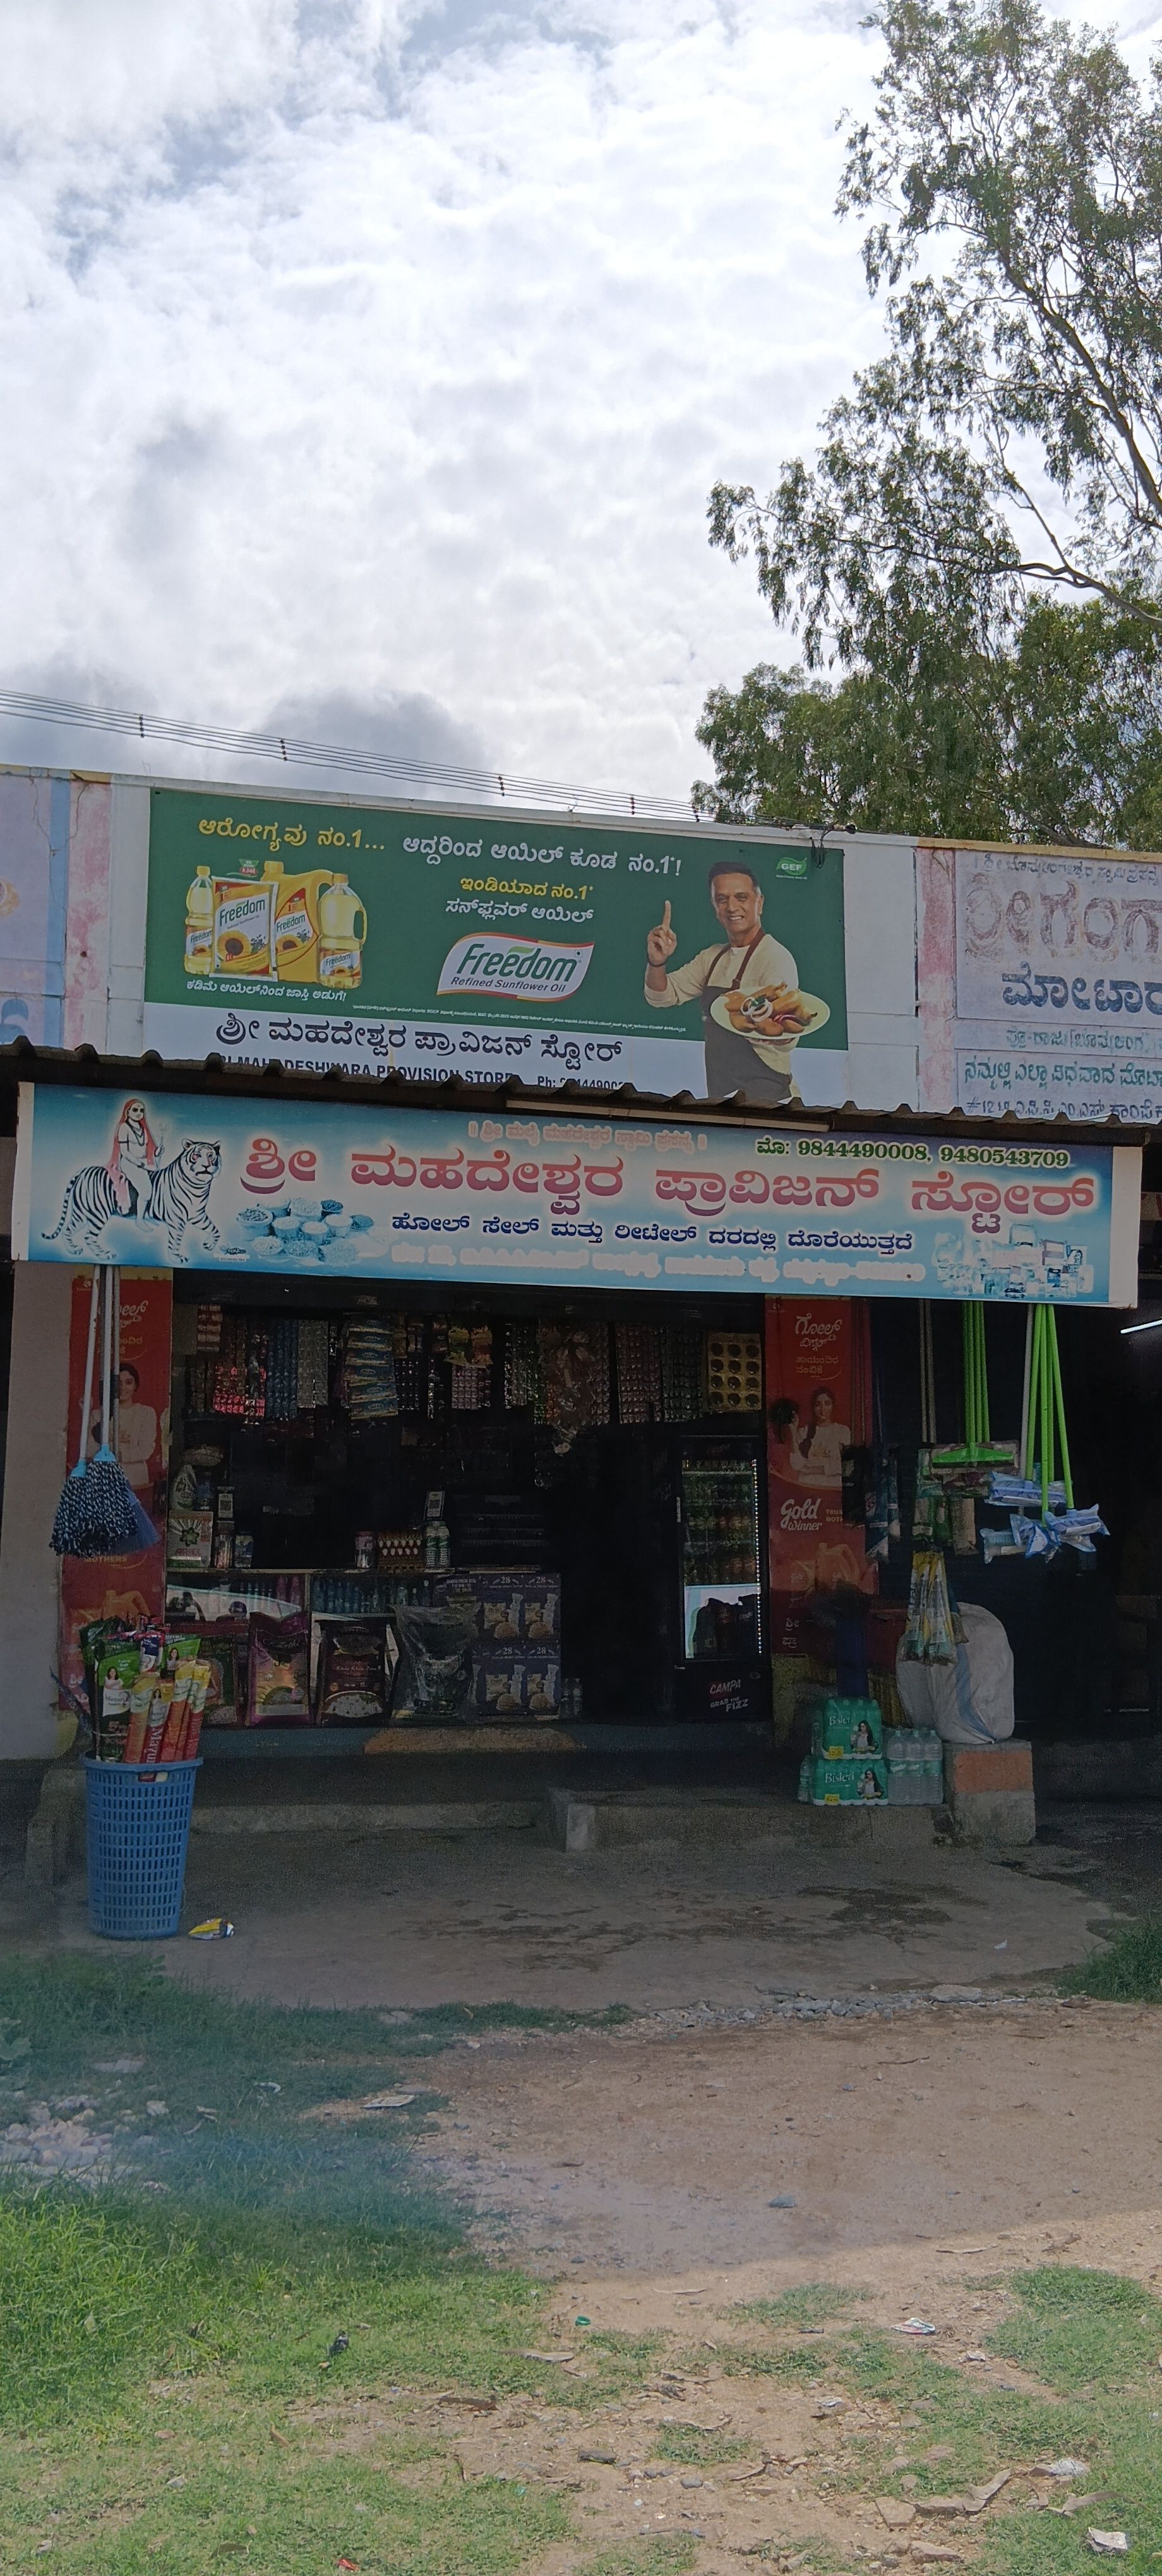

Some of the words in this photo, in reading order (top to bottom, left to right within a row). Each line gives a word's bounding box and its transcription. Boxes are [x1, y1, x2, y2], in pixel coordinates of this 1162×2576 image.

[198, 817, 307, 852] ಆರೋಗ್ಯವು
[402, 835, 483, 865] ಆದ್ದರಿಂದ
[491, 843, 564, 864] ಆಯಿಲ್
[570, 848, 618, 869] ಕೂಡ
[460, 876, 548, 896] ಇಂಡಿಯಾದ
[219, 899, 265, 927] Freedom
[276, 914, 306, 932] Freedom
[531, 906, 594, 922] ಆಯಿಲ್
[325, 953, 351, 966] Freedom
[457, 943, 577, 982] Freedom
[450, 976, 494, 988] Refined
[494, 979, 549, 991] Sunflower
[550, 983, 566, 993] Oil
[216, 1012, 260, 1045] ಶ್ರೀ
[268, 1017, 407, 1057] ಮಹದೇಶ್ವರ
[414, 1030, 532, 1056] ಪ್ರಾವಿಜನ್
[540, 1034, 623, 1071] ಸ್ಟೋರ್
[940, 1146, 1069, 1167] 9480543709
[240, 1137, 316, 1195] ಶ್ರೀ
[350, 1143, 624, 1216] ಮಹದೇಶ್ವರ
[655, 1167, 880, 1217] ಪ್ರಾವಿಜನ್
[911, 1171, 1094, 1234] ಸ್ಟೋರ್
[392, 1212, 470, 1232] ಹೋಲ್
[482, 1215, 539, 1235] ಸೇಲ್
[551, 1219, 603, 1244] ಮತ್ತು
[614, 1222, 697, 1242] ರೀಟೇಲ್
[709, 1227, 777, 1252] ದರದಲ್ಲಿ
[788, 1230, 913, 1255] ದೊರೆಯುತ್ತದೆ
[780, 1498, 822, 1529] Gold
[710, 1678, 741, 1695] CAMPA
[726, 1698, 749, 1712] FIZZ
[825, 1772, 854, 1784] Bisleri
